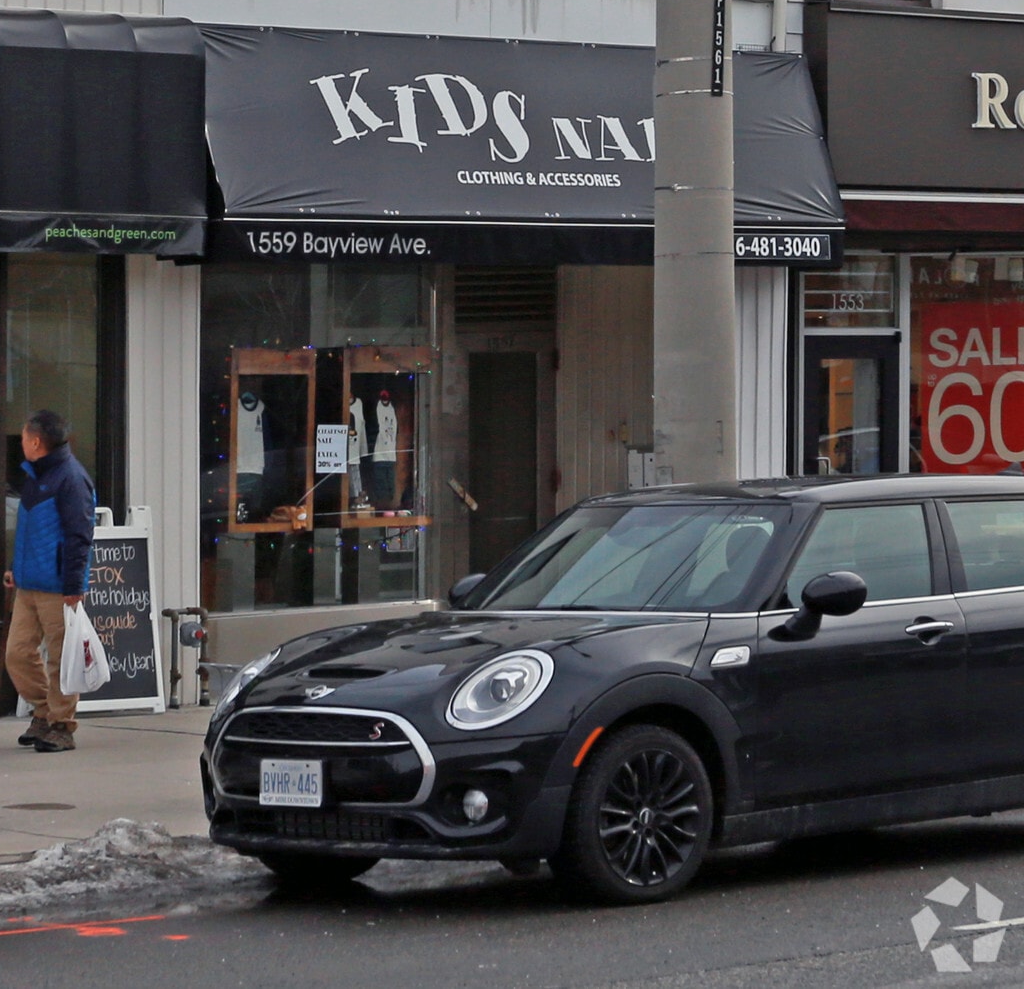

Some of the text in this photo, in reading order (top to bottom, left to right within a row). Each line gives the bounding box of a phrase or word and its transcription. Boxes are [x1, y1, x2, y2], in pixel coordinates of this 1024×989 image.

[971, 71, 1024, 129] R
[309, 67, 531, 163] KIDS
[457, 170, 622, 188] CLOTHING & ACCESSORIES
[45, 223, 176, 244] peachesandgreen.com
[247, 231, 432, 258] 1559 Bayview Ave.
[735, 236, 821, 258] 6-481-3040
[831, 293, 865, 311] 1553
[93, 542, 136, 564] time to
[88, 566, 125, 586] ETOX
[88, 587, 110, 606] the
[108, 586, 151, 612] holidays
[126, 648, 156, 679] Year!
